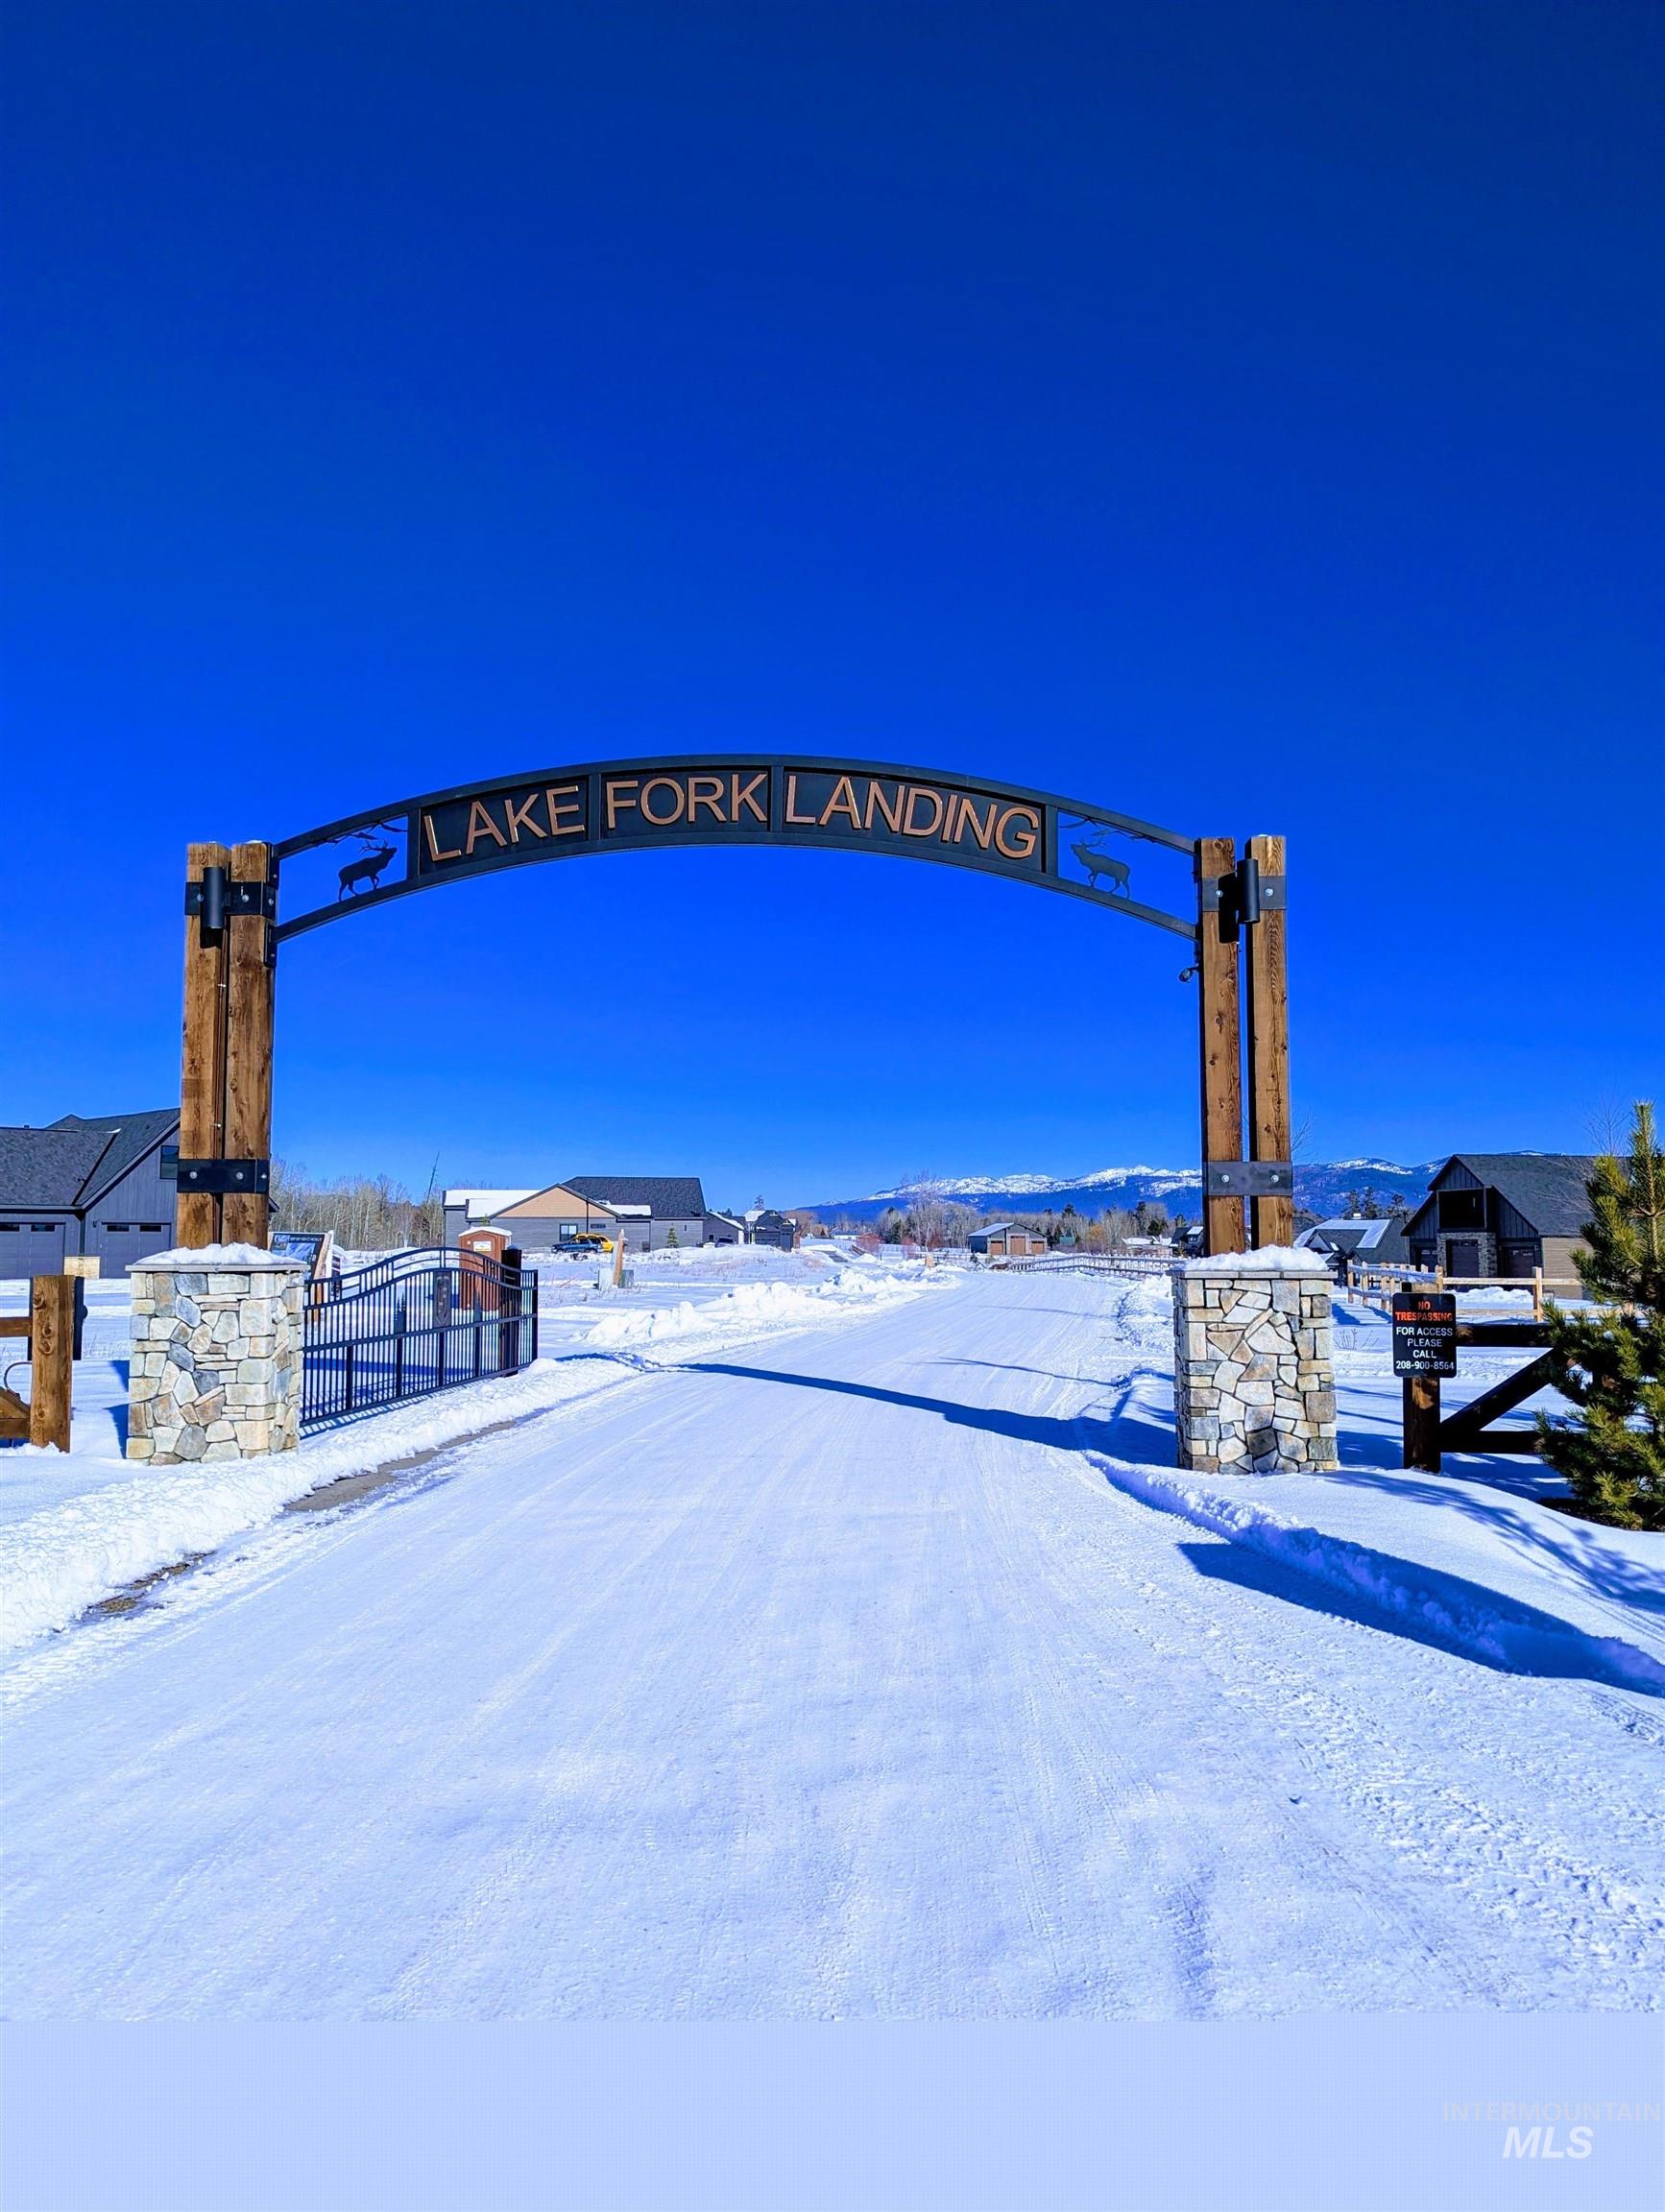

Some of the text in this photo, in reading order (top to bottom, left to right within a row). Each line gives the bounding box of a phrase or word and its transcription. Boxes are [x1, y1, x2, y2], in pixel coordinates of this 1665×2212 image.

[423, 774, 1039, 861] LAKE FORK LANDING
[1418, 1300, 1431, 1310] NO
[1395, 1311, 1454, 1322] TRESPASSING
[1396, 1326, 1453, 1336] FOR ACCESS
[1407, 1337, 1442, 1347] PLEASE
[1412, 1349, 1437, 1358] CALL
[1395, 1360, 1455, 1370] 208-900-8564
